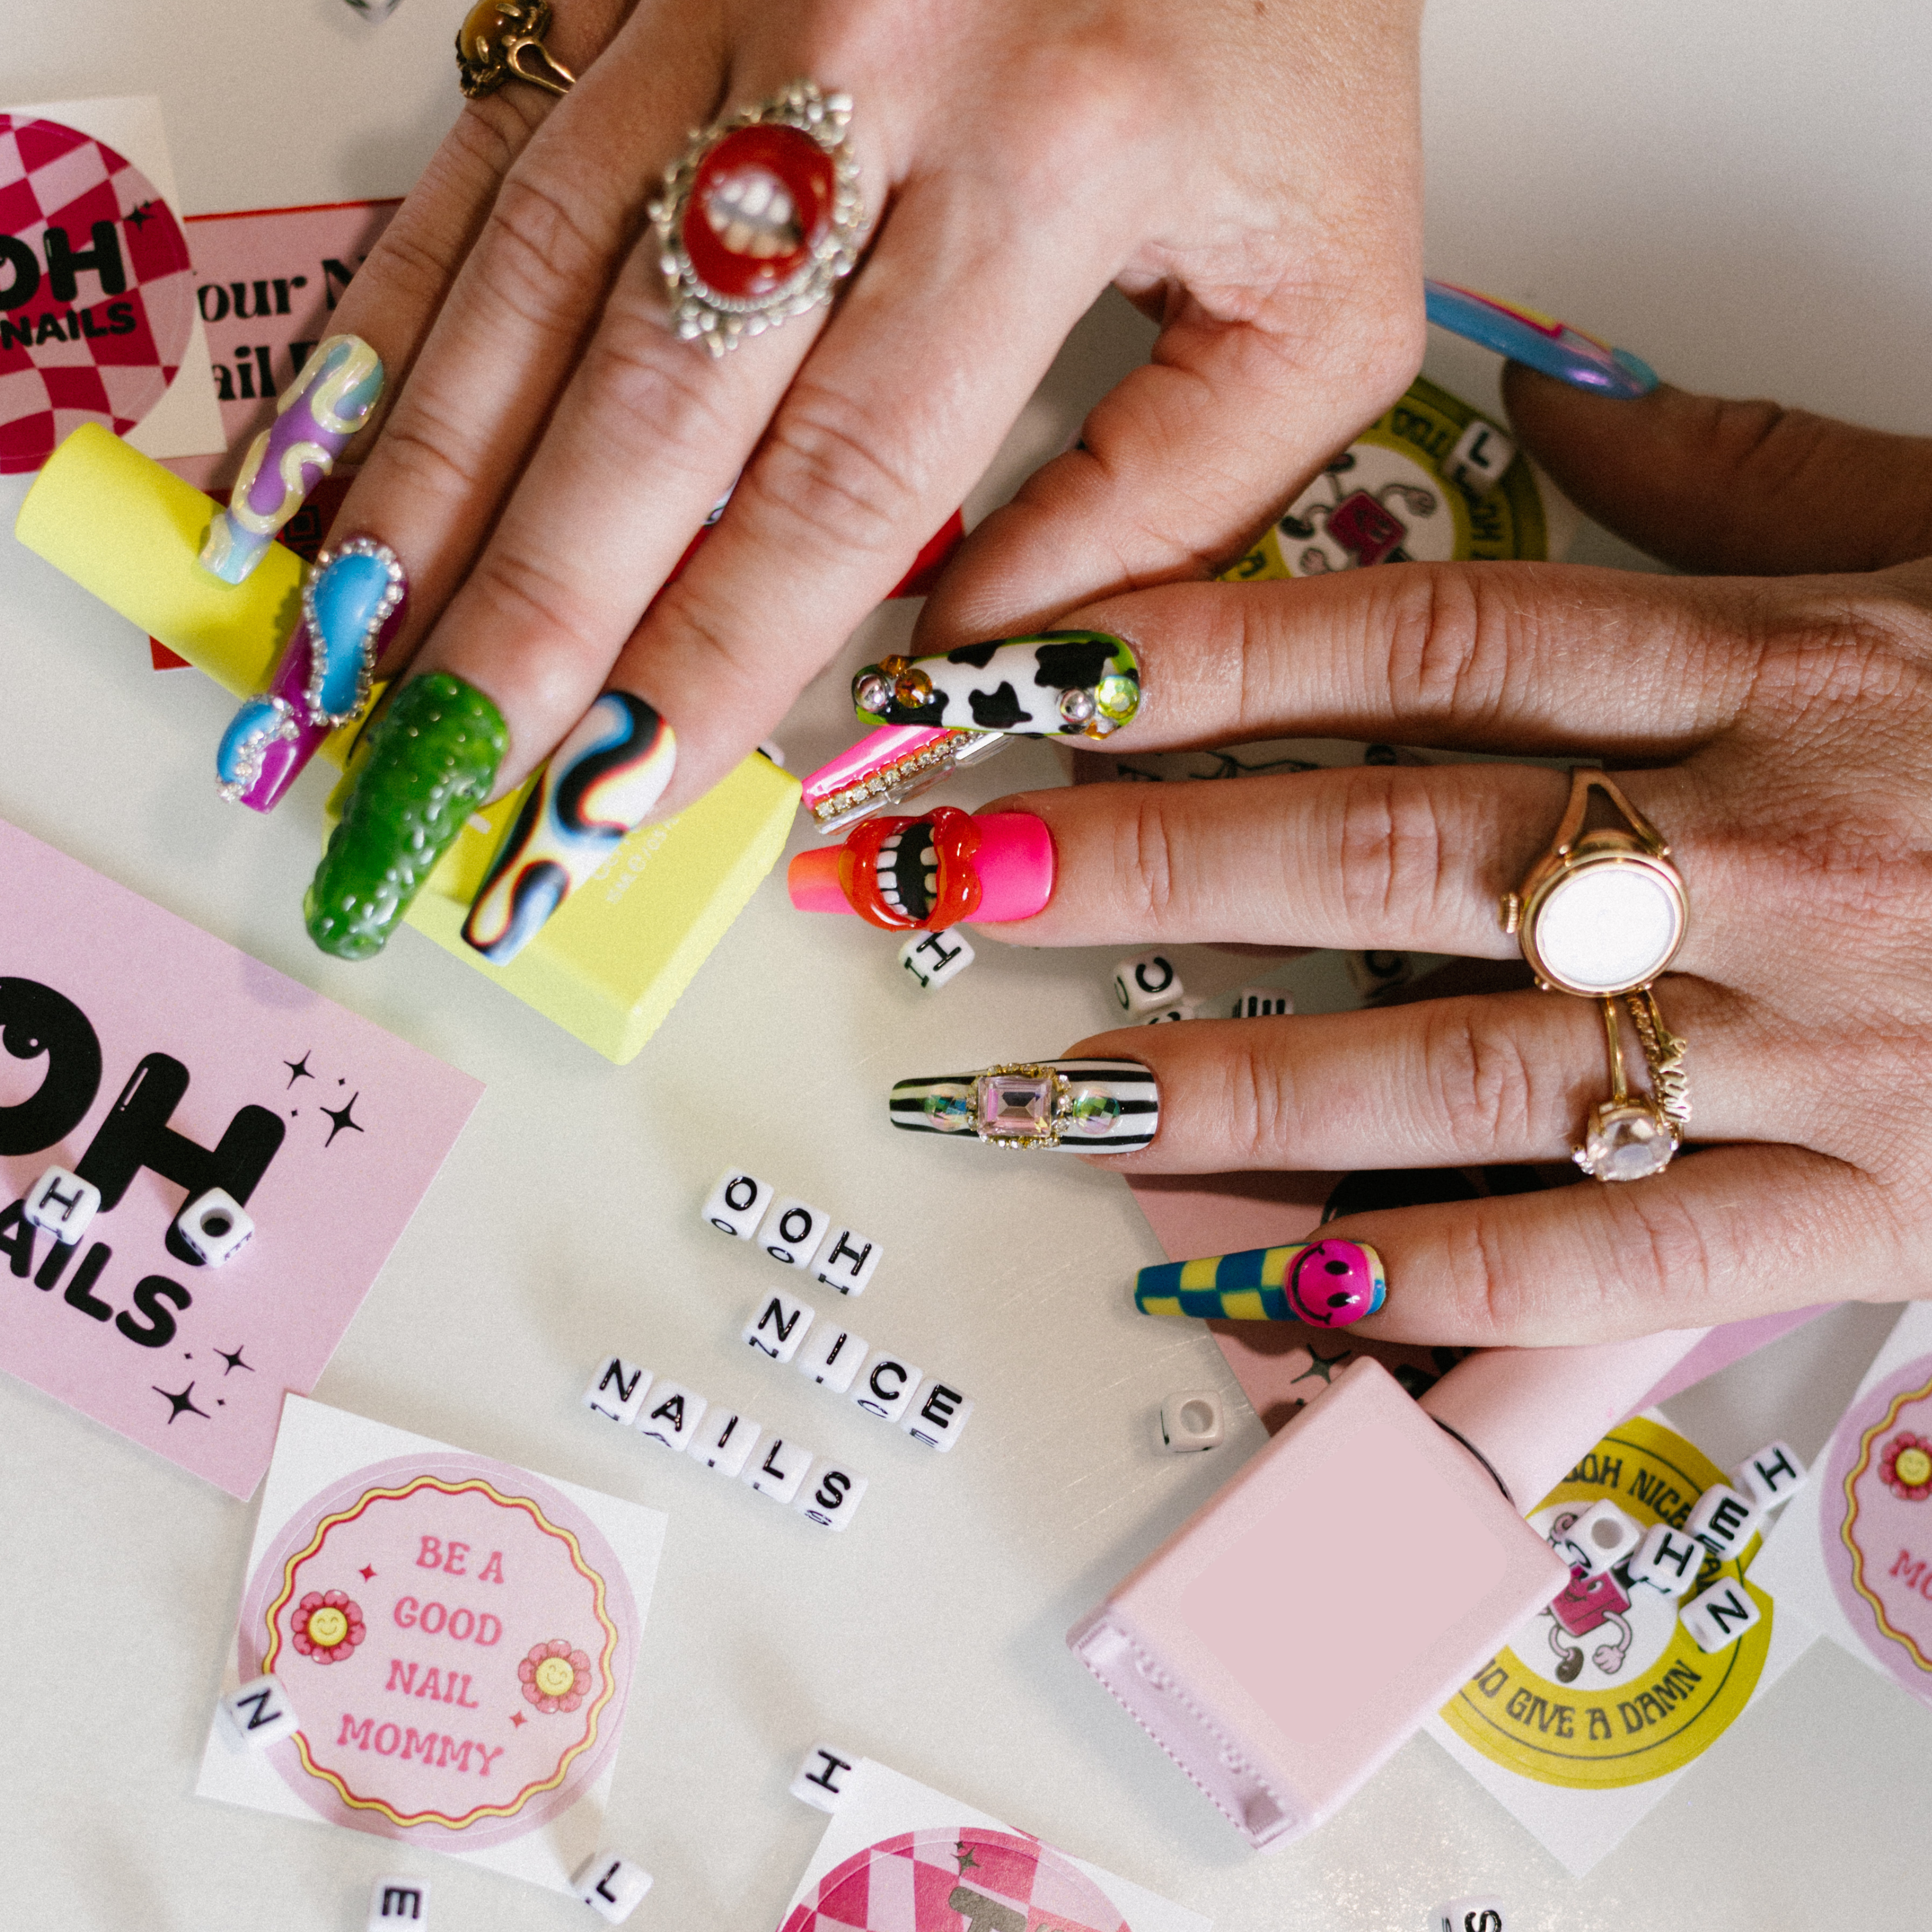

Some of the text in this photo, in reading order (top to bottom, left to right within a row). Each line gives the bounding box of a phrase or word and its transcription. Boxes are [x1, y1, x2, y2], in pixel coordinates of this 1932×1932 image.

[0, 303, 137, 350] NAILS
[197, 276, 307, 322] our
[725, 1176, 872, 1277] OOH
[757, 1298, 963, 1429] NICE
[599, 1358, 851, 1509] NAILS
[416, 1535, 505, 1585] BE A
[393, 1596, 502, 1646] GOOD
[385, 1659, 479, 1709] NAIL
[1506, 1687, 1575, 1739] GIVE
[1586, 1708, 1612, 1740] A
[1617, 1659, 1702, 1735] DAMN
[336, 1714, 504, 1777] MOMMY
